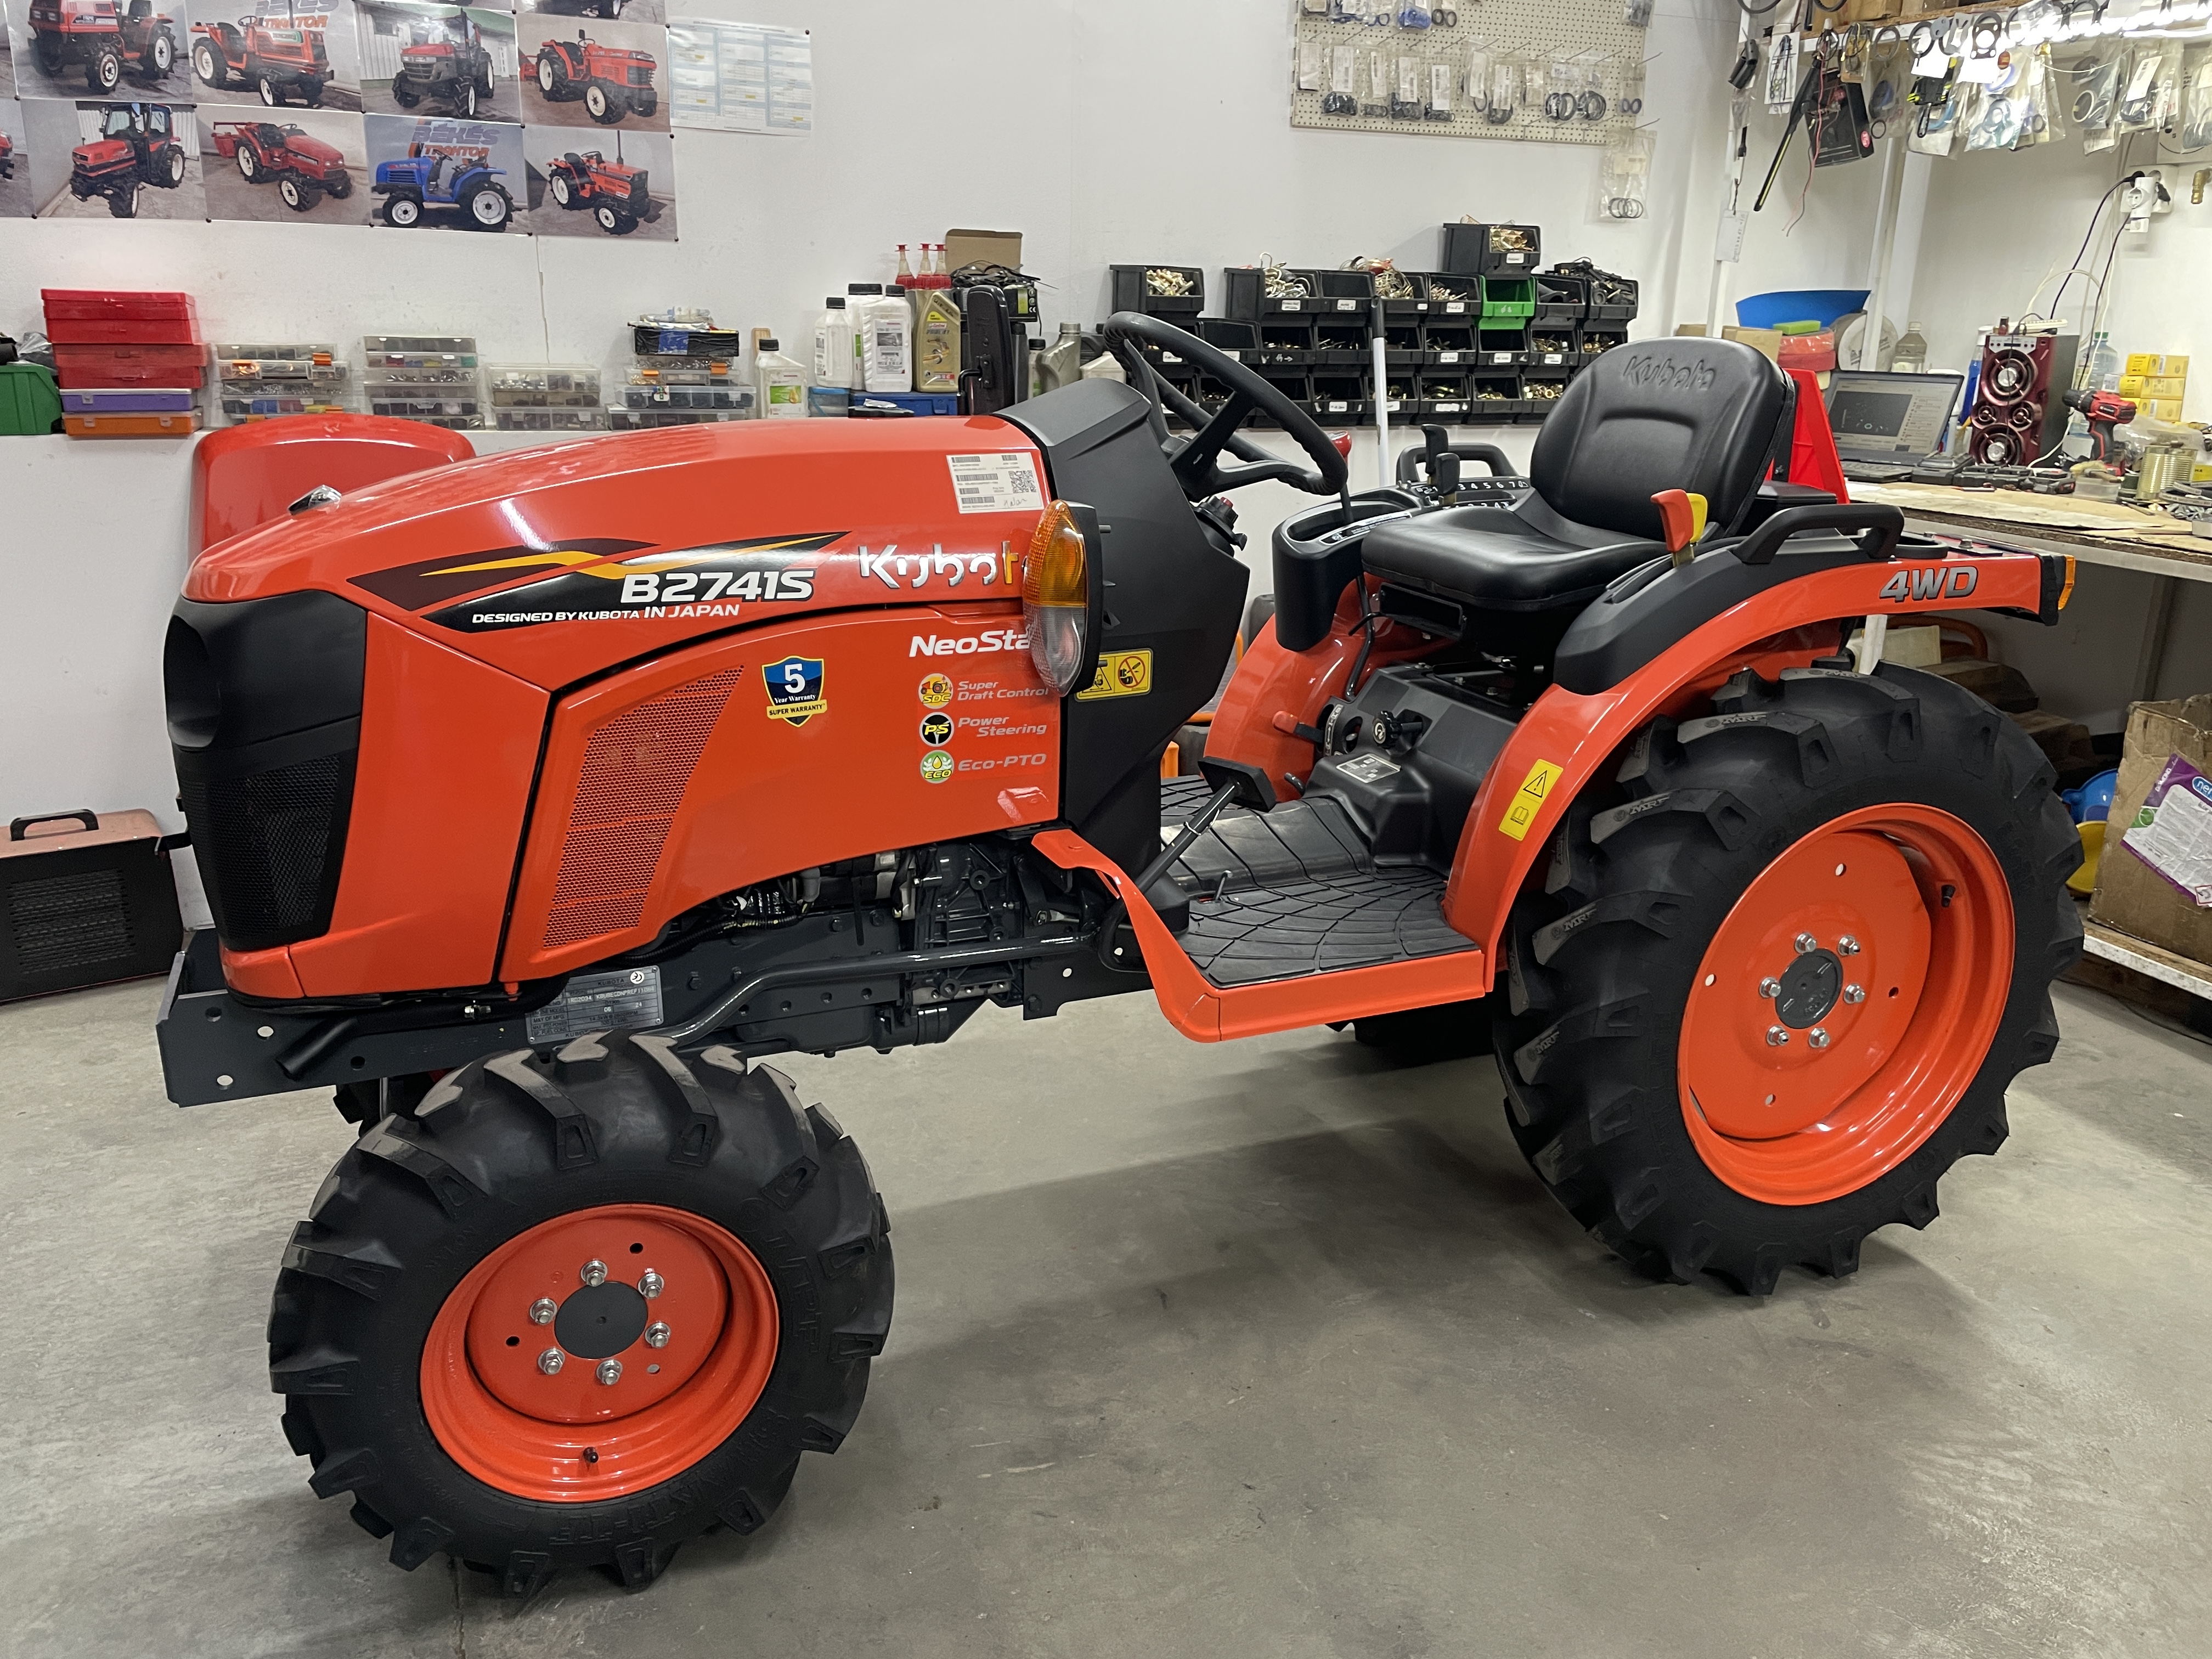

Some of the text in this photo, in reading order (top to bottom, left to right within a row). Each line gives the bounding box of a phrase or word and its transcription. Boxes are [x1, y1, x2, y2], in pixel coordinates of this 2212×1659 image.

[412, 123, 501, 145] BÉKÉS
[1623, 356, 1717, 390] Kubota
[858, 540, 1028, 589] Kubot
[620, 570, 814, 603] B2741S
[1879, 566, 1978, 602] 4WD
[472, 604, 740, 623] DESIGNED BY KUBOTA IN JAPAN
[909, 629, 1031, 658] NeoSta
[785, 663, 805, 693] 5
[957, 680, 999, 691] Super
[788, 694, 816, 702] Warranty
[922, 693, 951, 704] SDC
[957, 687, 1049, 701] Draft Control
[789, 704, 823, 713] WARRANTY
[958, 716, 1009, 727] Power
[1722, 714, 1767, 726] MRF
[924, 724, 950, 736] PS
[977, 724, 1047, 737] Steering
[958, 753, 1047, 771] Eco-PTO
[924, 769, 952, 779] ECO
[1629, 797, 1670, 815] MRF
[1563, 909, 1597, 932] MRF
